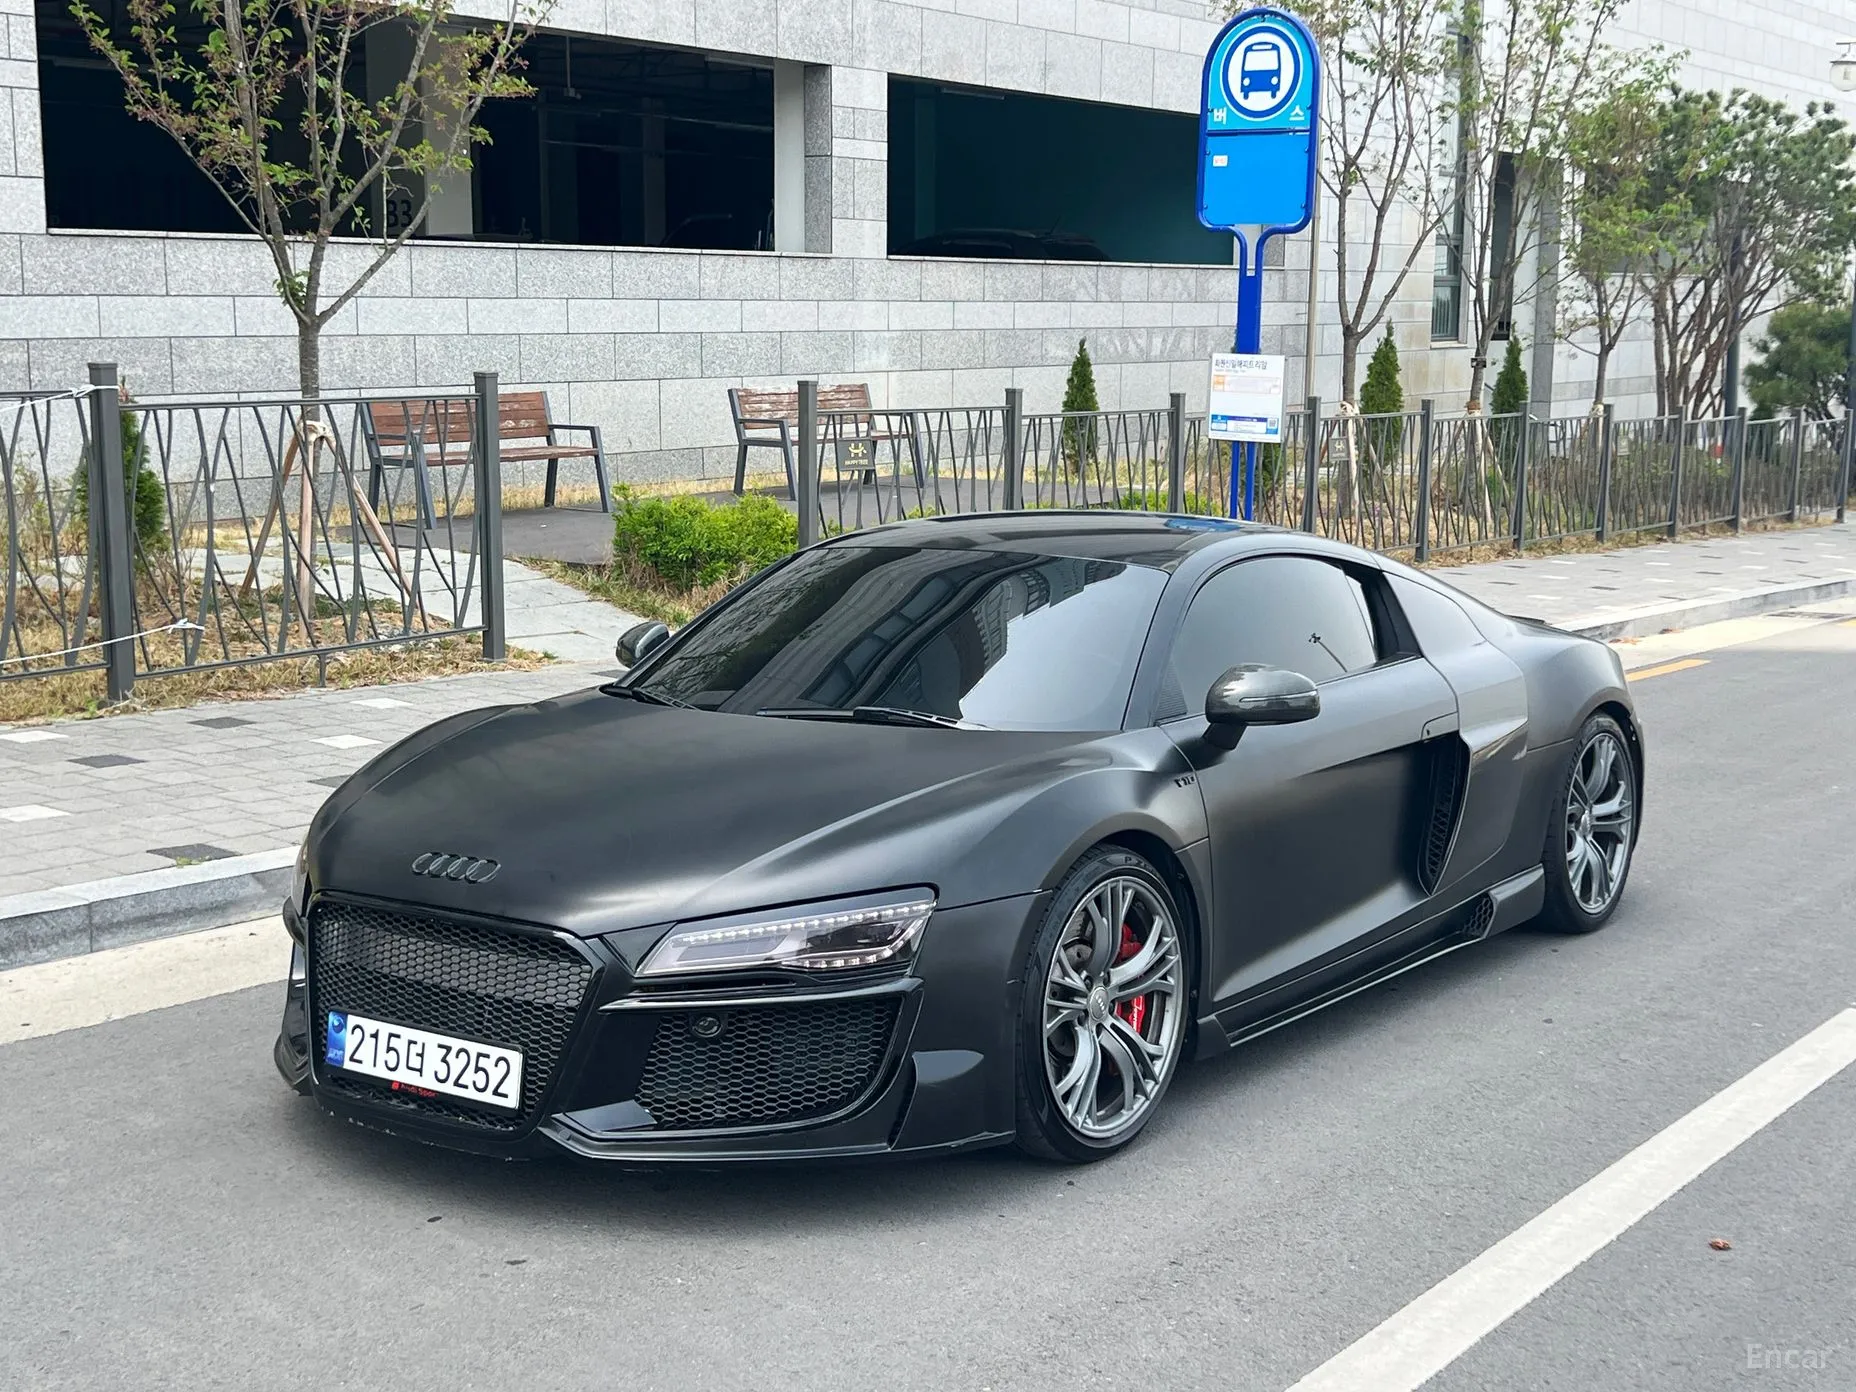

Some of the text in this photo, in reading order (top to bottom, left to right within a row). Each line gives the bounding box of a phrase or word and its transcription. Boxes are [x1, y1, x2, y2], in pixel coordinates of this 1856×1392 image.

[1213, 105, 1305, 125] 버 스
[349, 1024, 511, 1099] 215더 3252
